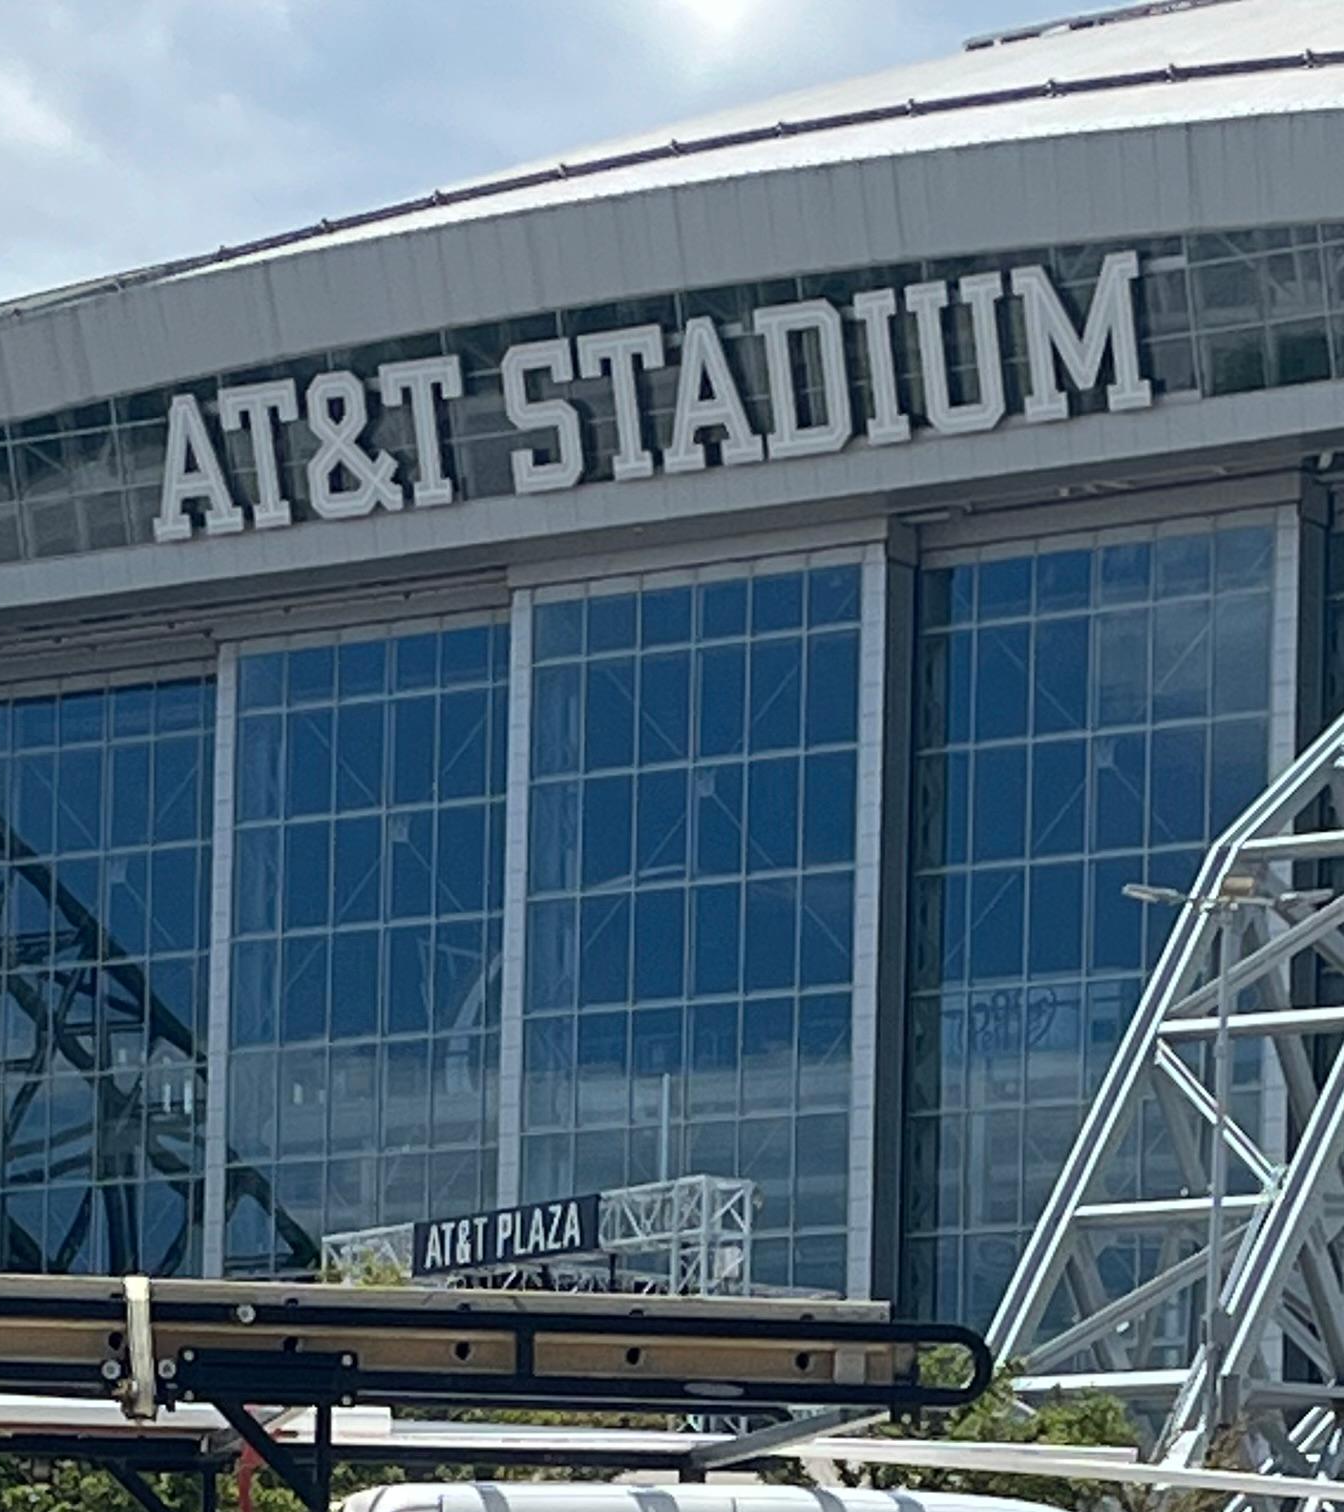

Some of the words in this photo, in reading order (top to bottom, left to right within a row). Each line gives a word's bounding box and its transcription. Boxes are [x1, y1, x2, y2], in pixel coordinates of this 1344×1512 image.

[153, 355, 463, 542] AT&T
[501, 250, 1152, 495] STADIUM
[424, 1216, 489, 1269] AT&T
[495, 1201, 582, 1258] PLAZA
